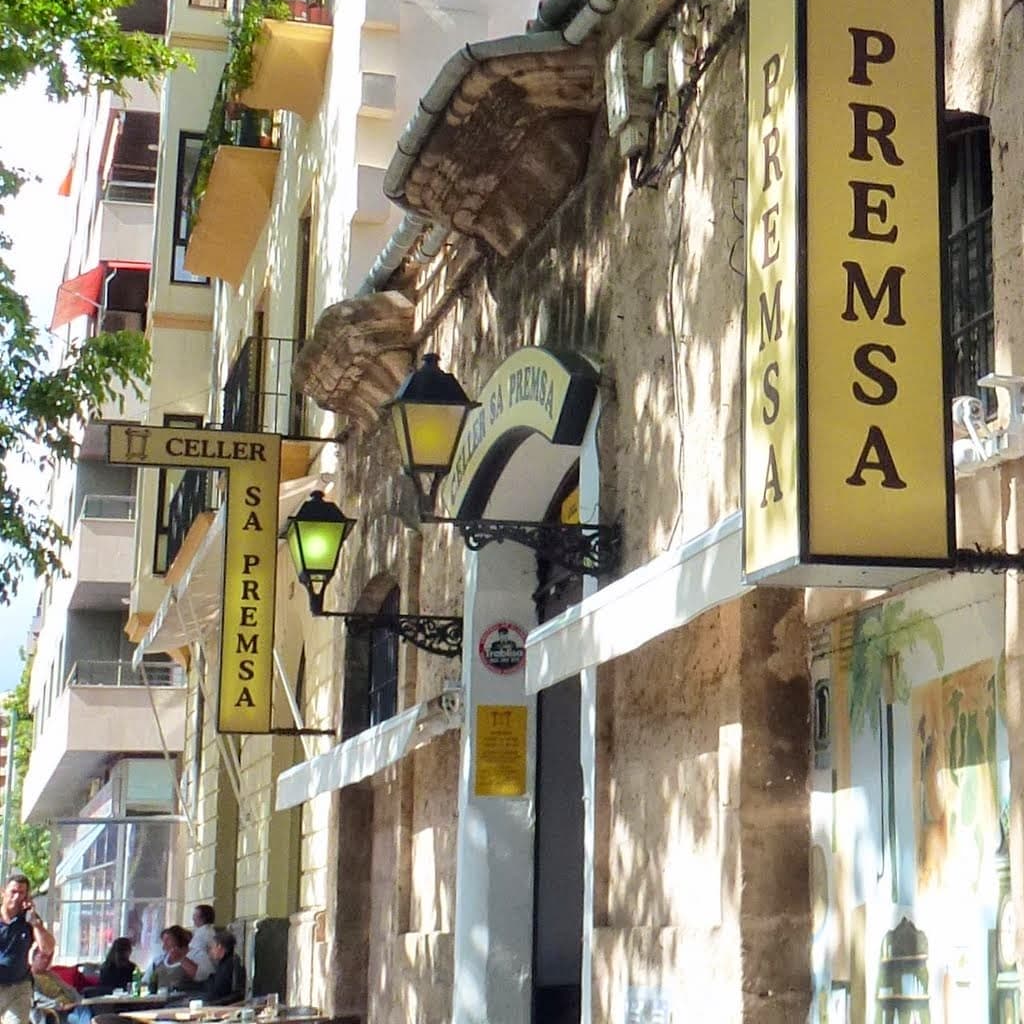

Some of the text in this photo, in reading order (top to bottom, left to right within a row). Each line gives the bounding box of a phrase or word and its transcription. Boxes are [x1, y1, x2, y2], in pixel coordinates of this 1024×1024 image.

[759, 52, 784, 509] PREMSA
[841, 26, 907, 490] PREMSA
[165, 437, 267, 461] CELLER
[451, 366, 554, 505] CELLER SA PREMSA
[234, 486, 263, 708] SA PREMSA
